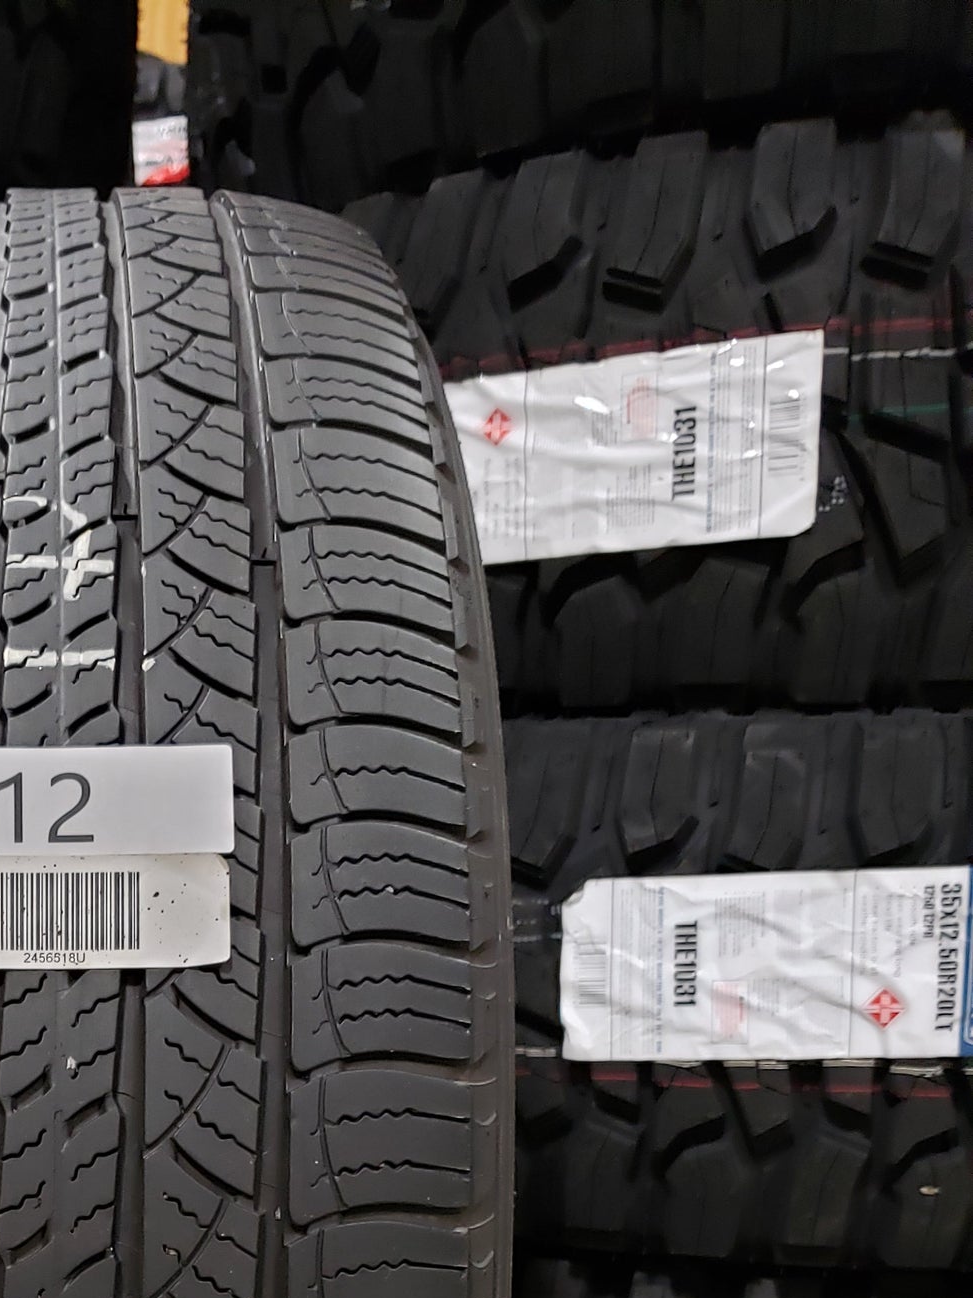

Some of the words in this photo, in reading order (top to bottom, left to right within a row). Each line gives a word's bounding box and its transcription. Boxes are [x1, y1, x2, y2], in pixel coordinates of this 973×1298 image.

[672, 406, 697, 500] THE1031
[23, 952, 86, 963] 2456518U
[674, 920, 697, 1007] THE1031
[936, 883, 962, 1032] 35x12.50R20LT
